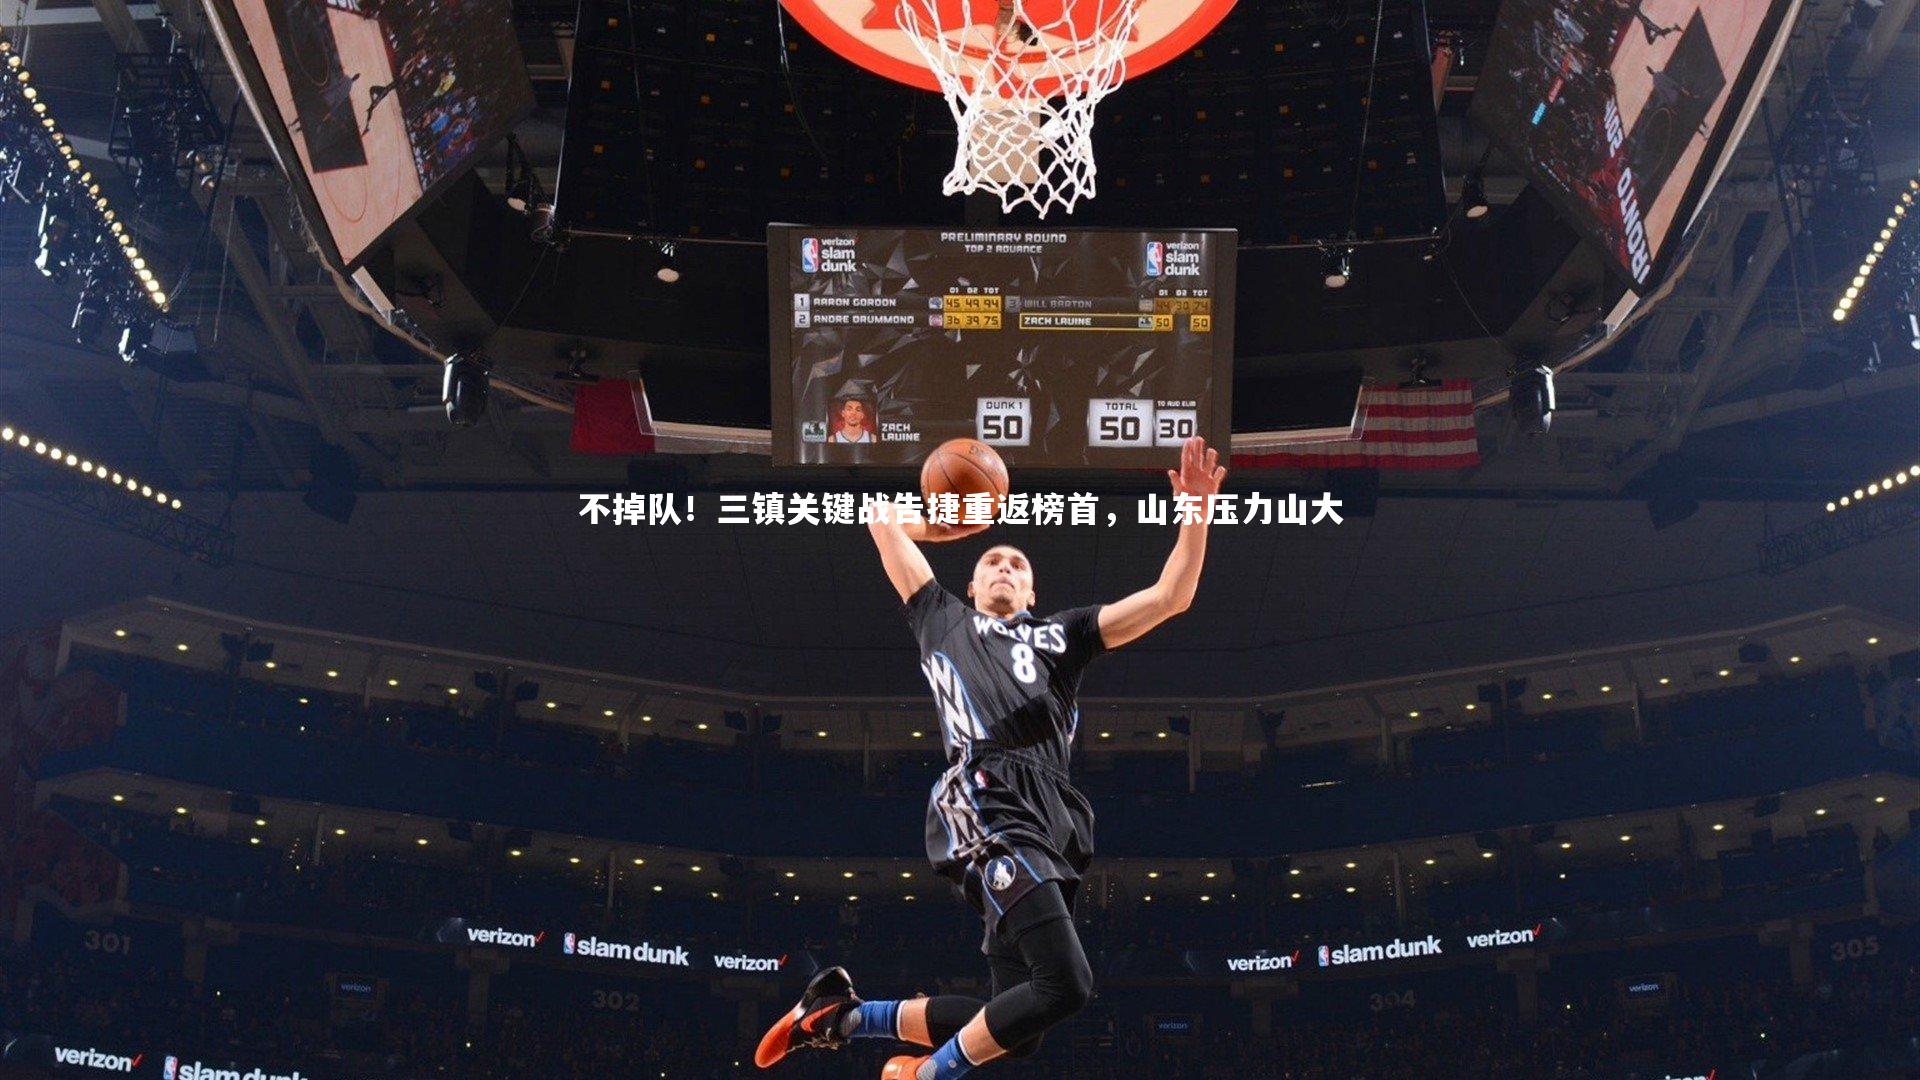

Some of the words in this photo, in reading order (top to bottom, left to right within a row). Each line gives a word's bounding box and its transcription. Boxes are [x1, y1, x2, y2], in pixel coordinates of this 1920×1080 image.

[1617, 167, 1650, 284] RONTO
[821, 237, 855, 246] verizon
[941, 232, 1021, 242] PRELIMINARY
[1025, 233, 1067, 243] ROUND
[965, 245, 984, 253] TOP
[987, 245, 993, 253] 2
[1166, 241, 1199, 250] verizon
[821, 246, 856, 259] slam
[1165, 250, 1199, 263] slam
[821, 259, 857, 272] dunk
[1164, 263, 1200, 276] dunk
[799, 297, 804, 307] 1
[813, 299, 850, 307] AARON
[853, 299, 897, 307] GORDON
[946, 300, 960, 308] 45
[966, 300, 980, 308] 49
[984, 300, 999, 308] 94
[799, 314, 807, 324] 2
[814, 315, 850, 323] ANDRE
[853, 316, 915, 324] DRUMMOND
[984, 316, 998, 325] 75
[1024, 316, 1051, 325] ZACH
[1156, 318, 1170, 327] 50
[1193, 318, 1208, 327] 50
[986, 401, 1015, 409] DUNK
[1105, 402, 1138, 411] TOTAL
[881, 423, 911, 432] ZACH
[983, 415, 1023, 440] 50
[1100, 416, 1140, 441] 50
[1159, 419, 1193, 438] 30
[1011, 643, 1037, 684] 8
[467, 927, 535, 948] verizon
[1467, 926, 1534, 949] verizon
[577, 937, 631, 961] slam
[633, 942, 689, 967] dunk
[1331, 944, 1384, 966] slam
[1385, 935, 1442, 958] dunk
[714, 954, 778, 972] verizon
[1227, 953, 1291, 972] verizon
[341, 983, 371, 994] verizon
[55, 1046, 131, 1072] verizon
[178, 1061, 240, 1080] slam
